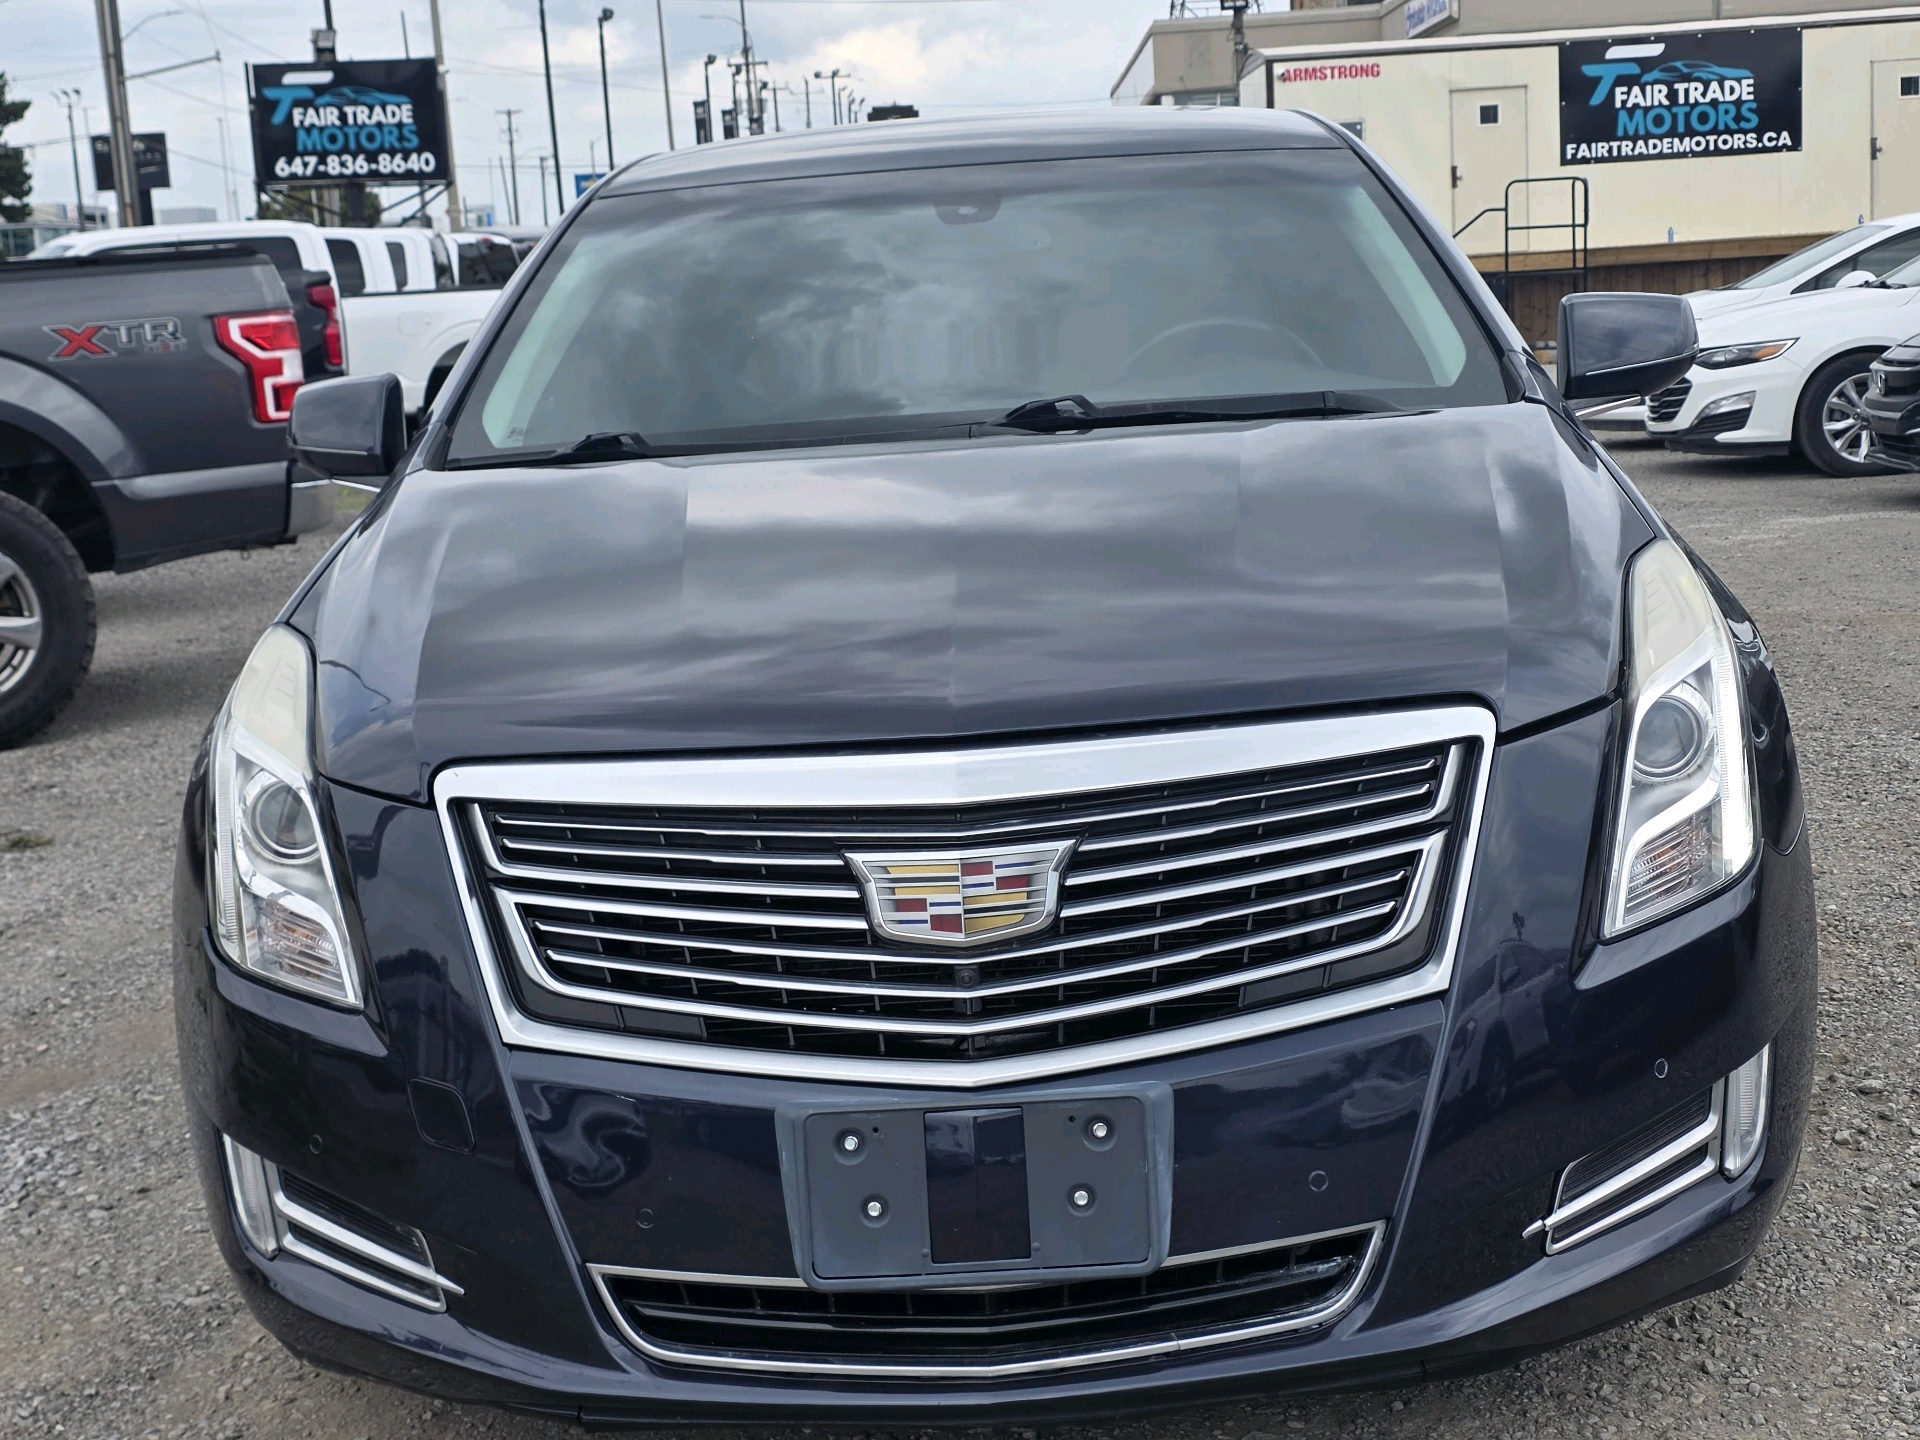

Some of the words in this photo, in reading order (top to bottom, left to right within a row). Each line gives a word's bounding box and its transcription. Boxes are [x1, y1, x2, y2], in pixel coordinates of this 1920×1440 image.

[1282, 63, 1380, 83] ARMSTRONG
[1614, 83, 1669, 109] FAIR
[1674, 78, 1755, 105] TRADE
[292, 106, 341, 128] FAIR
[343, 103, 415, 126] TRADE
[1616, 101, 1759, 137] MOTORS
[296, 123, 421, 152] MOTORS
[1566, 131, 1792, 160] FAIRTRADEMOTORS.CA
[274, 151, 436, 179] 647-836-8640
[42, 318, 187, 361] XTR
